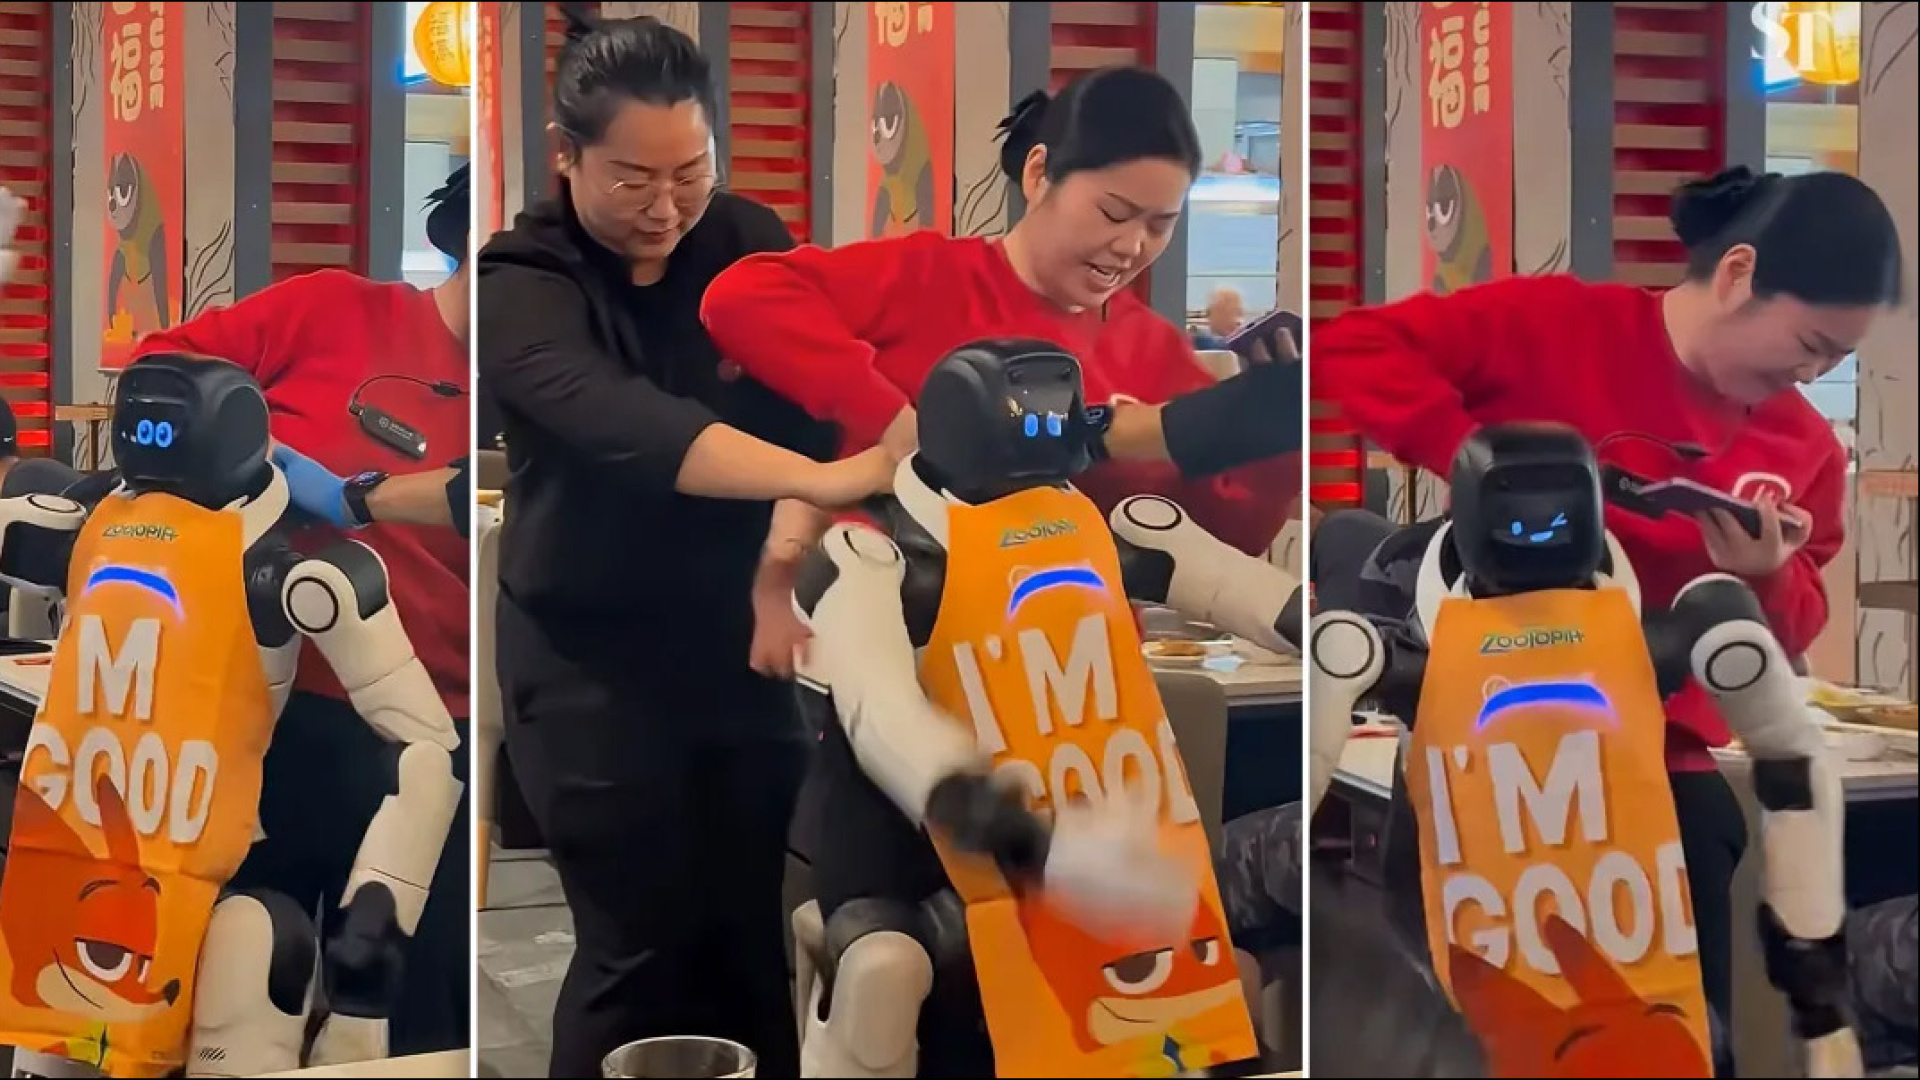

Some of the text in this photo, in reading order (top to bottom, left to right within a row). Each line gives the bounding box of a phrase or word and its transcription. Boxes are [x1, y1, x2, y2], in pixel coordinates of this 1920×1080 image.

[111, 2, 142, 122] 福
[1428, 2, 1465, 129] 福
[1474, 2, 1490, 114] UNE
[953, 613, 1118, 753] I'M
[21, 721, 218, 843] GOOD
[1425, 729, 1608, 865] I'M
